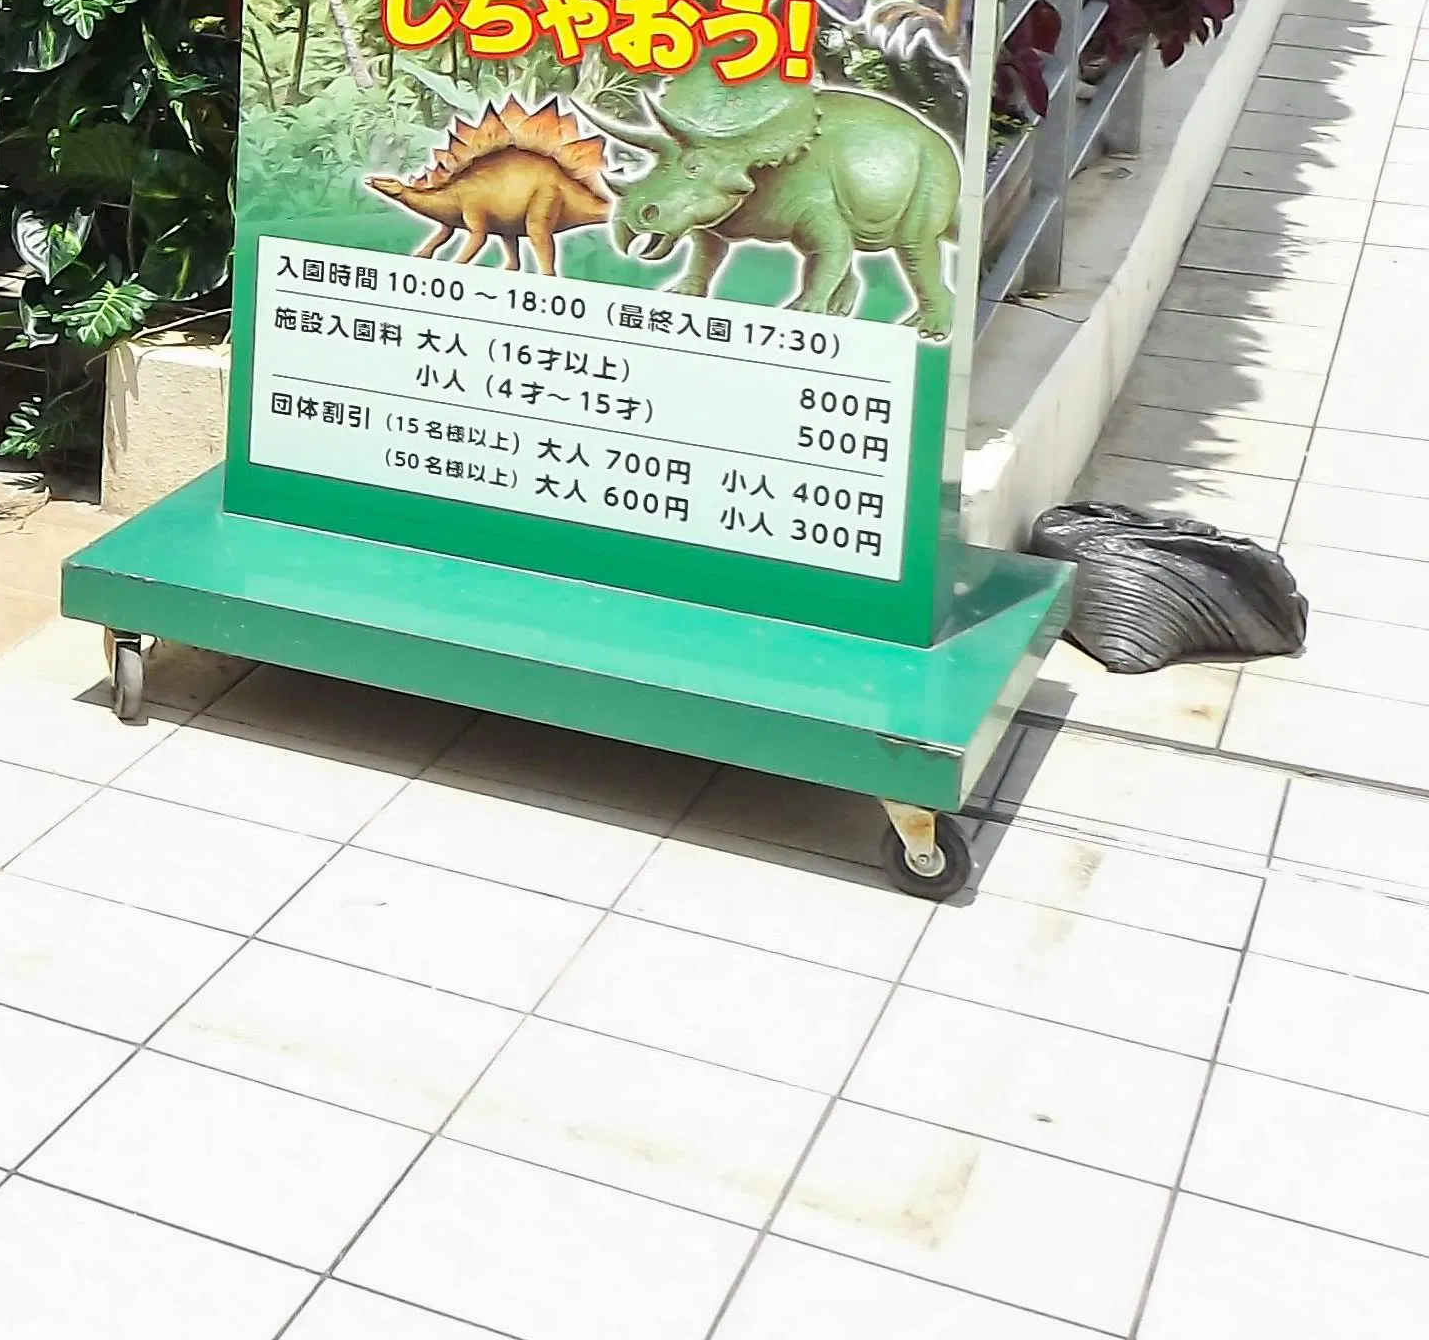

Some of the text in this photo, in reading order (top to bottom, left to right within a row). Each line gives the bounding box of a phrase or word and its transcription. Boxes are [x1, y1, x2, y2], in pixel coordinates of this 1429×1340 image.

[277, 255, 377, 291] 入園時間
[389, 272, 464, 301] 10:00
[507, 288, 586, 320] 18:00
[743, 323, 841, 359] 17:30)
[274, 306, 403, 347] 施設入園料
[417, 329, 468, 358] 大人
[799, 388, 892, 424] 800円
[416, 364, 466, 393] 小人
[797, 426, 889, 463] 500円
[271, 392, 884, 519] 団体割引 (15名様以上) 大人 700円 小人 400円
[384, 447, 882, 557] (50名様以上) 大人 600円 小人 300円
